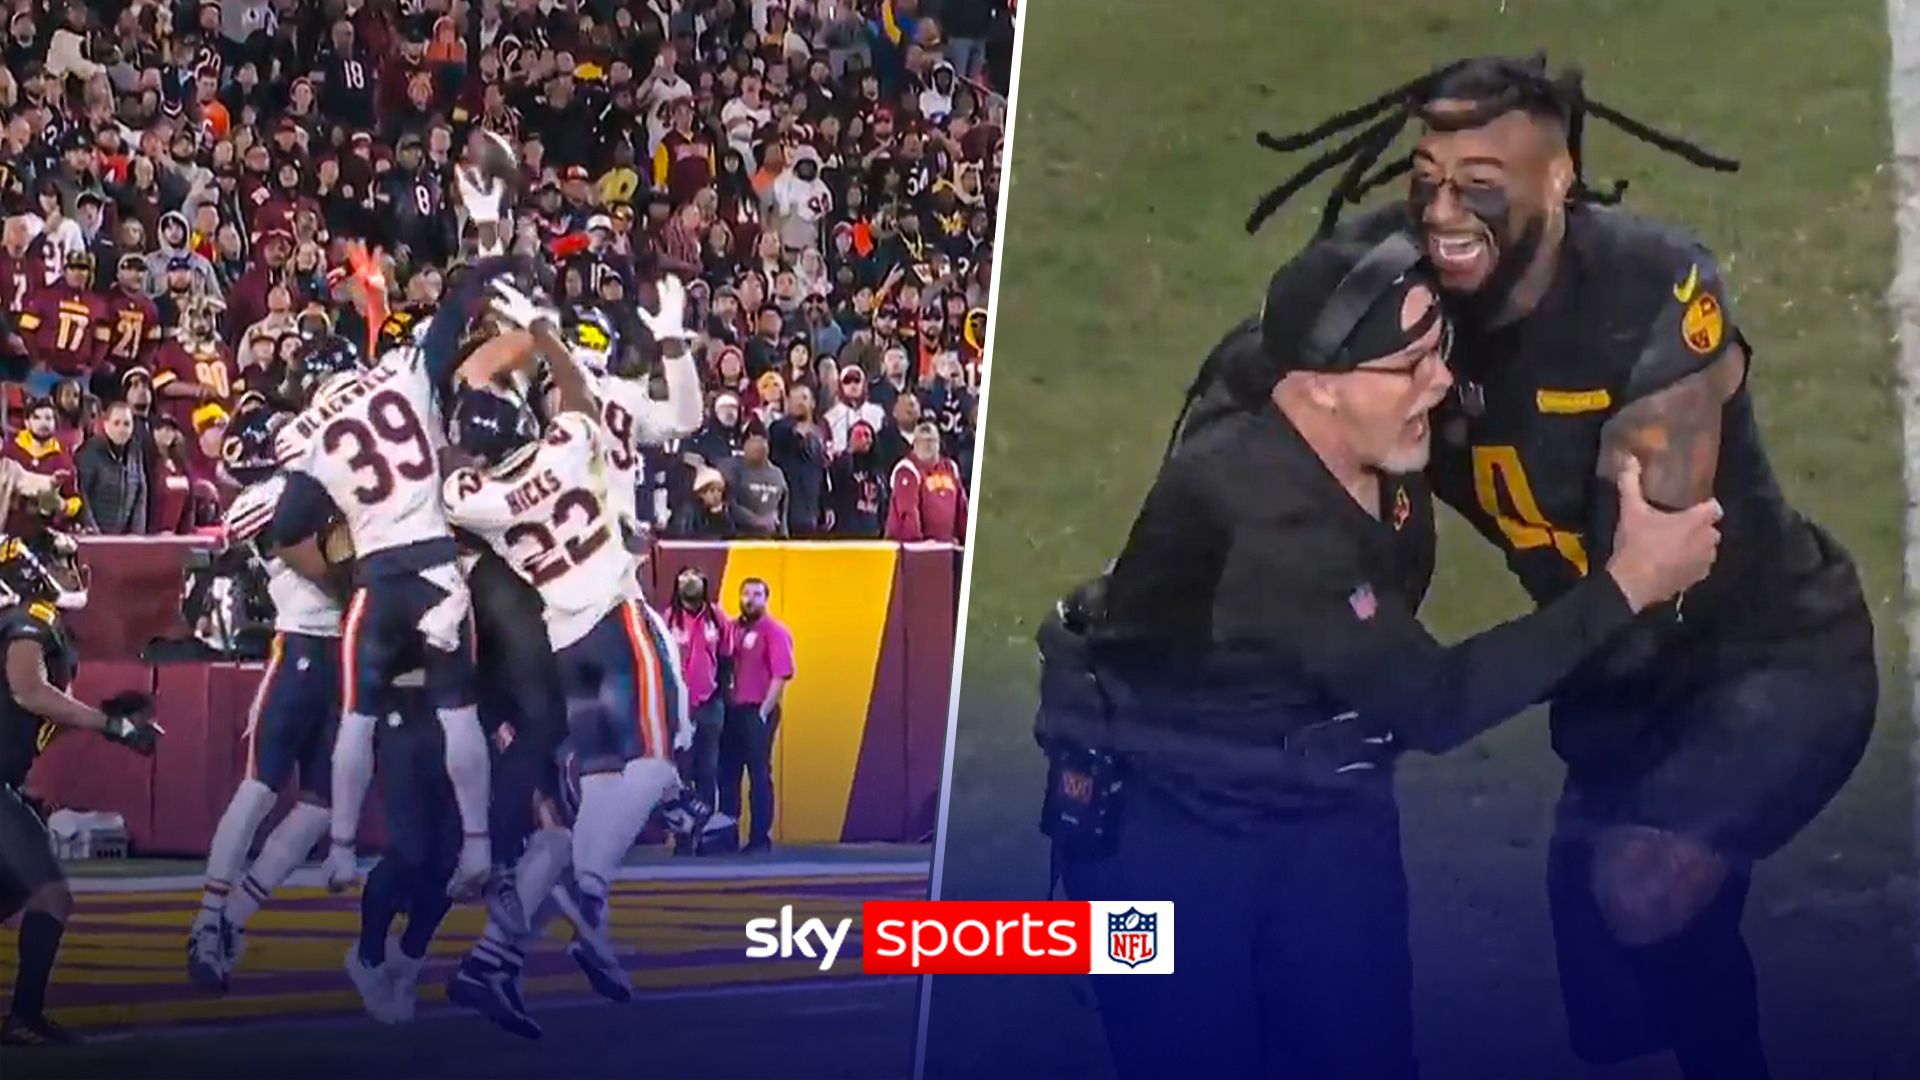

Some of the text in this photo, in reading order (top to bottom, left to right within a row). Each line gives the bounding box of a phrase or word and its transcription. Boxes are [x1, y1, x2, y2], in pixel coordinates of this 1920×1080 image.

[343, 60, 366, 90] 18
[415, 185, 431, 216] 8
[57, 312, 89, 352] 17
[111, 318, 143, 360] 21
[322, 389, 434, 504] 39
[504, 467, 562, 517] HICKS
[503, 486, 612, 588] 22
